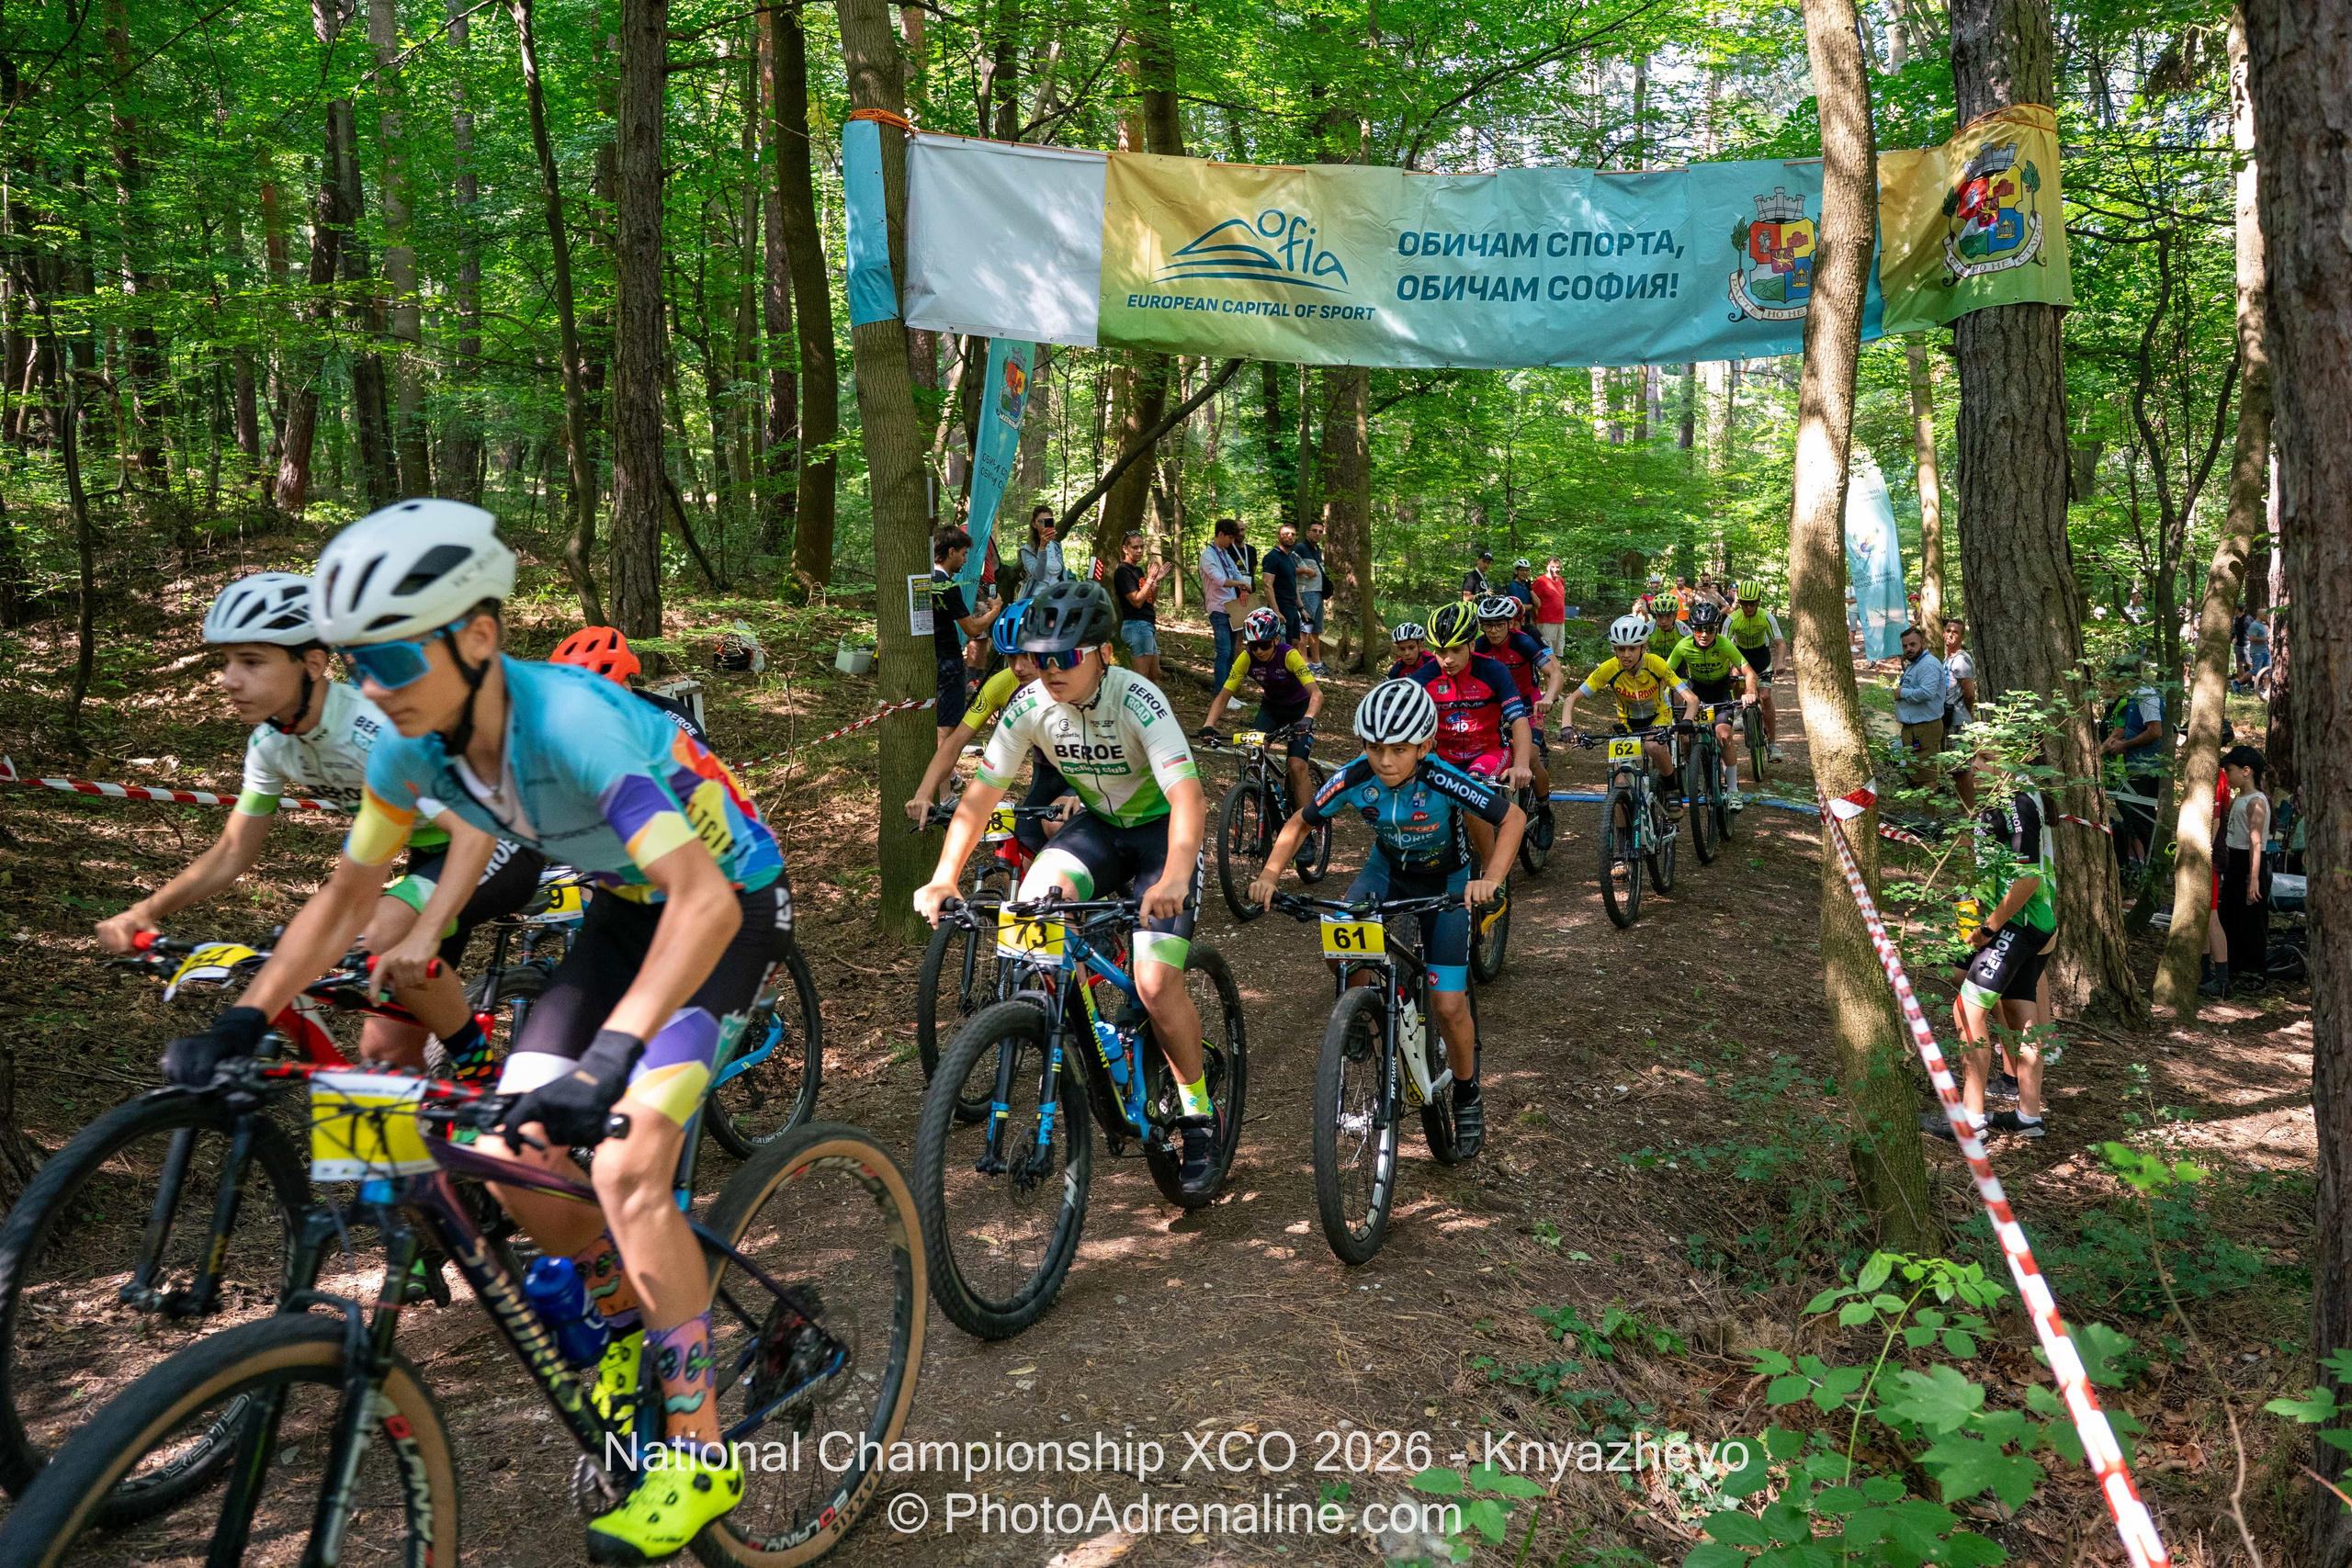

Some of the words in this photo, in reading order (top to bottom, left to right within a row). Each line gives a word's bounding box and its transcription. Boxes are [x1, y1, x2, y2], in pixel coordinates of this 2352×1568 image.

[1397, 231, 1538, 258] ОБИЧАМ
[1546, 230, 1685, 259] СПОРТА,
[1972, 264, 1986, 274] НО
[1992, 260, 2011, 270] НЕ
[1396, 275, 1540, 302] ОБИЧАМ
[1547, 272, 1679, 303] СОФИЯ!
[1731, 278, 1758, 317] РАСТЕ
[1767, 310, 1783, 319] НО
[1788, 309, 1804, 318] НЕ
[1126, 294, 1219, 311] EUROPEAN
[1221, 299, 1290, 317] CAPITAL
[1295, 303, 1317, 318] OF
[1319, 305, 1375, 321] SPORT
[1126, 697, 1151, 722] ROAD
[1128, 683, 1168, 719] BEROE
[1054, 744, 1125, 761] BEROE
[1614, 743, 1634, 756] 62
[1062, 765, 1101, 774] cycling
[1101, 765, 1127, 773] club
[1426, 769, 1489, 809] POMORIE
[549, 887, 564, 909] 9
[1013, 919, 1046, 948] 73
[1333, 926, 1366, 950] 61
[1981, 929, 2016, 980] BEROE
